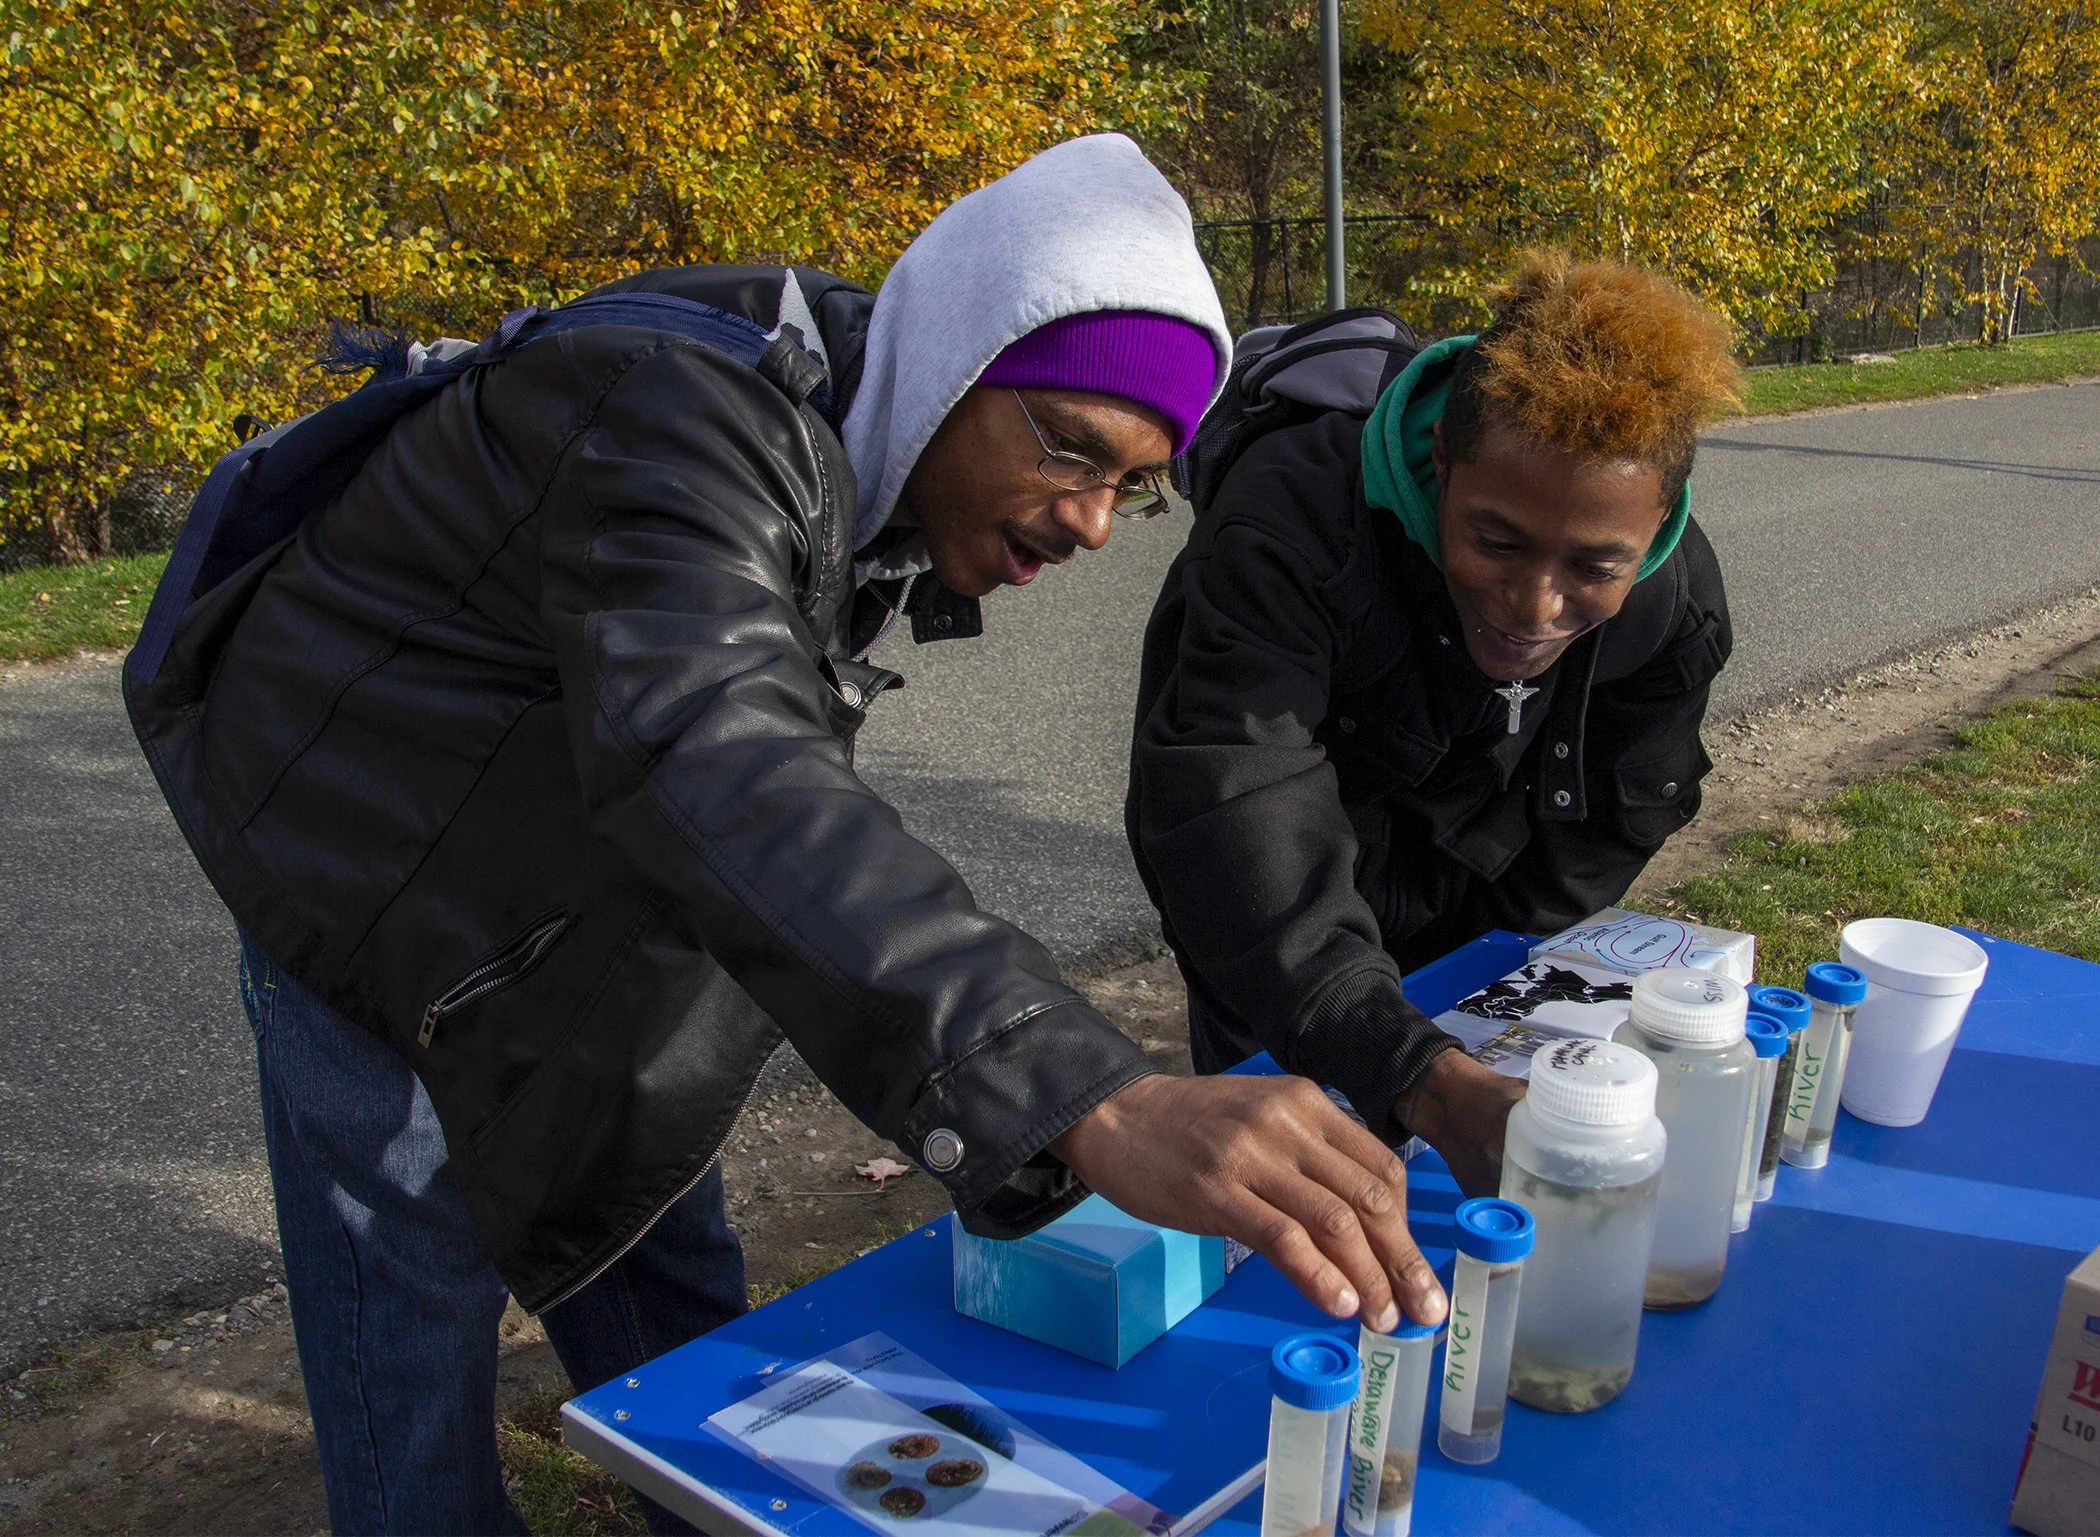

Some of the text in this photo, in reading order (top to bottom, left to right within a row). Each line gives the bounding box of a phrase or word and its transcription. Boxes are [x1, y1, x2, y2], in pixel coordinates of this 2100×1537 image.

[1628, 933, 1667, 956] Gulf Stream
[1788, 1042, 1821, 1122] River
[1445, 1295, 1471, 1392] River
[2062, 1414, 2097, 1443] L10
[1348, 1454, 1374, 1521] River
